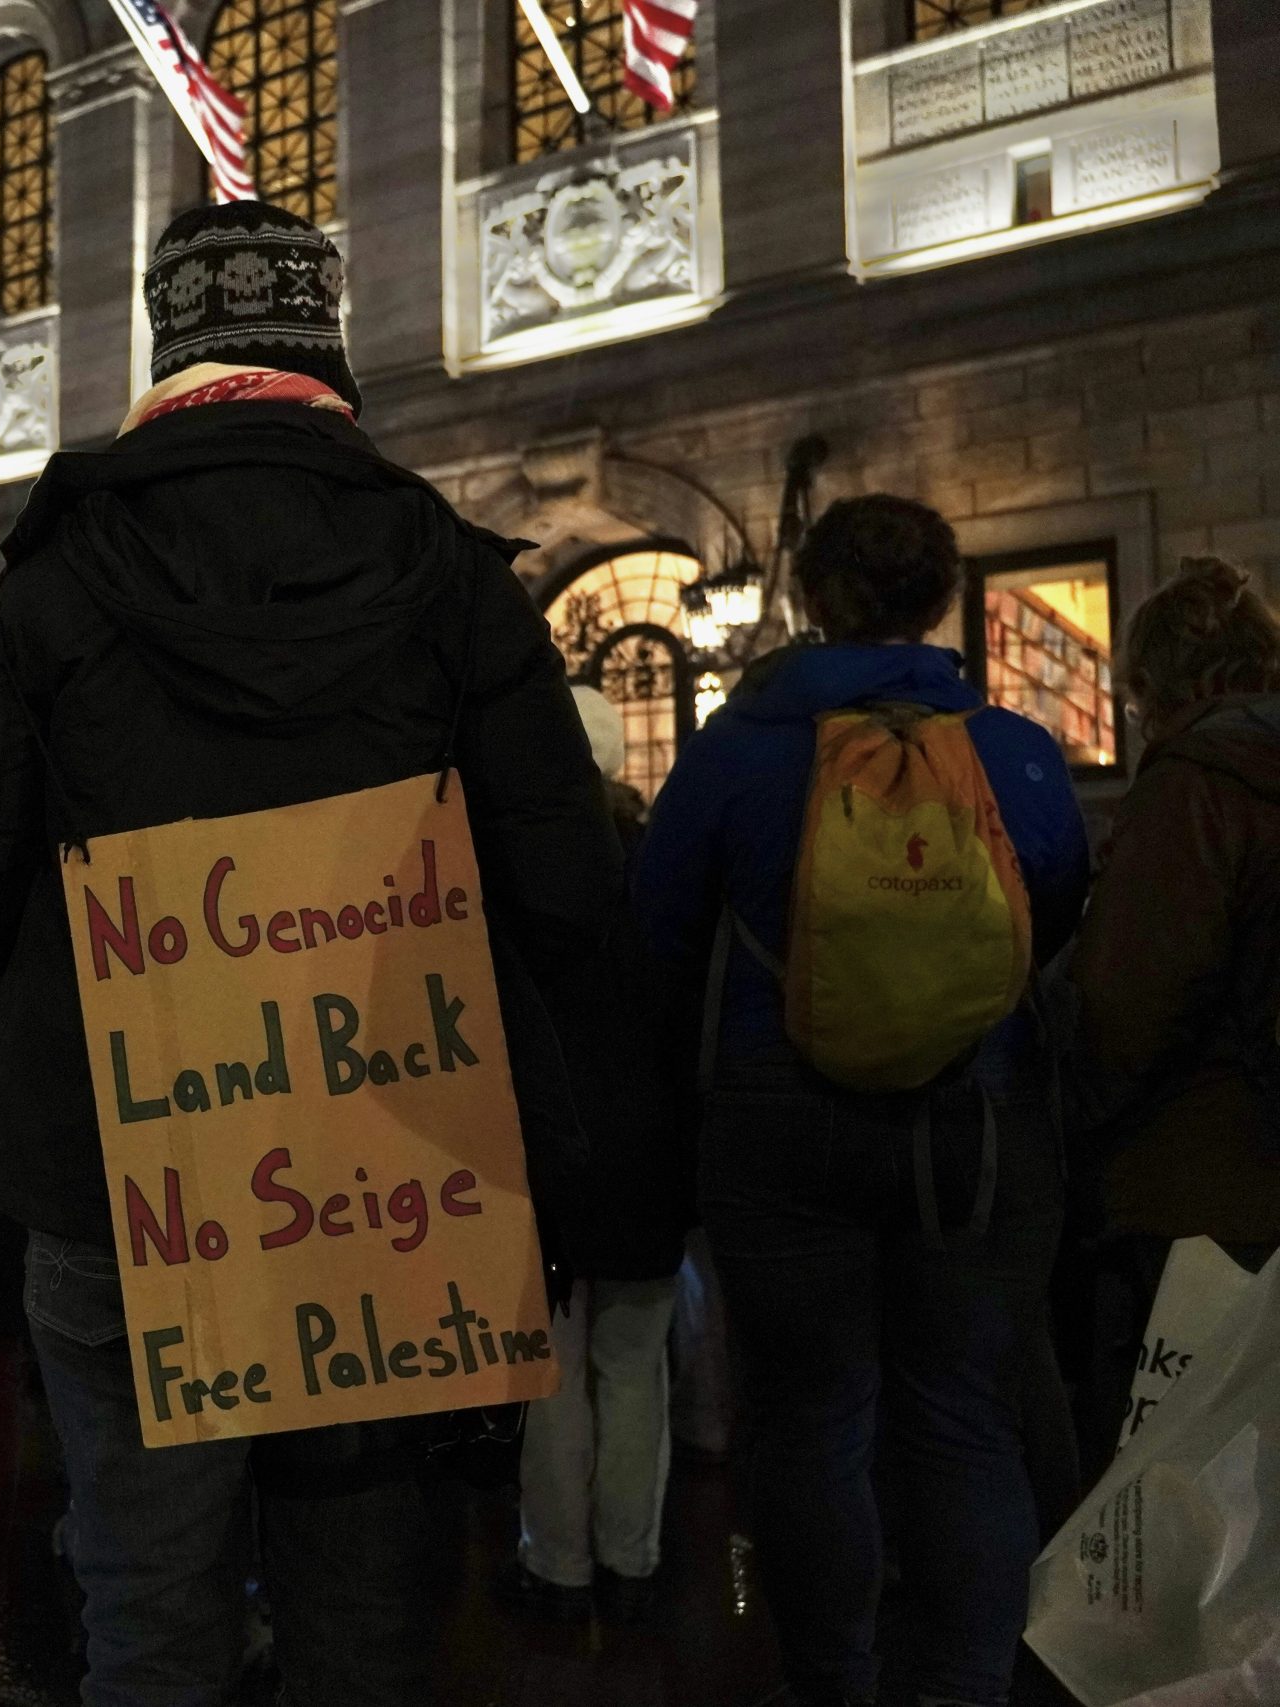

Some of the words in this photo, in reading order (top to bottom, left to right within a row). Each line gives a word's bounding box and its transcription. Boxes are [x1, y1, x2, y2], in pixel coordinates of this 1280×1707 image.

[83, 876, 188, 982] No
[203, 839, 469, 959] Genocide
[867, 875, 963, 897] cotopaxi
[109, 1000, 292, 1125] Land
[313, 973, 481, 1096] Back
[124, 1166, 230, 1267] No
[250, 1146, 483, 1254] Seige
[142, 1325, 272, 1423] Free
[295, 1280, 552, 1397] Palestine
